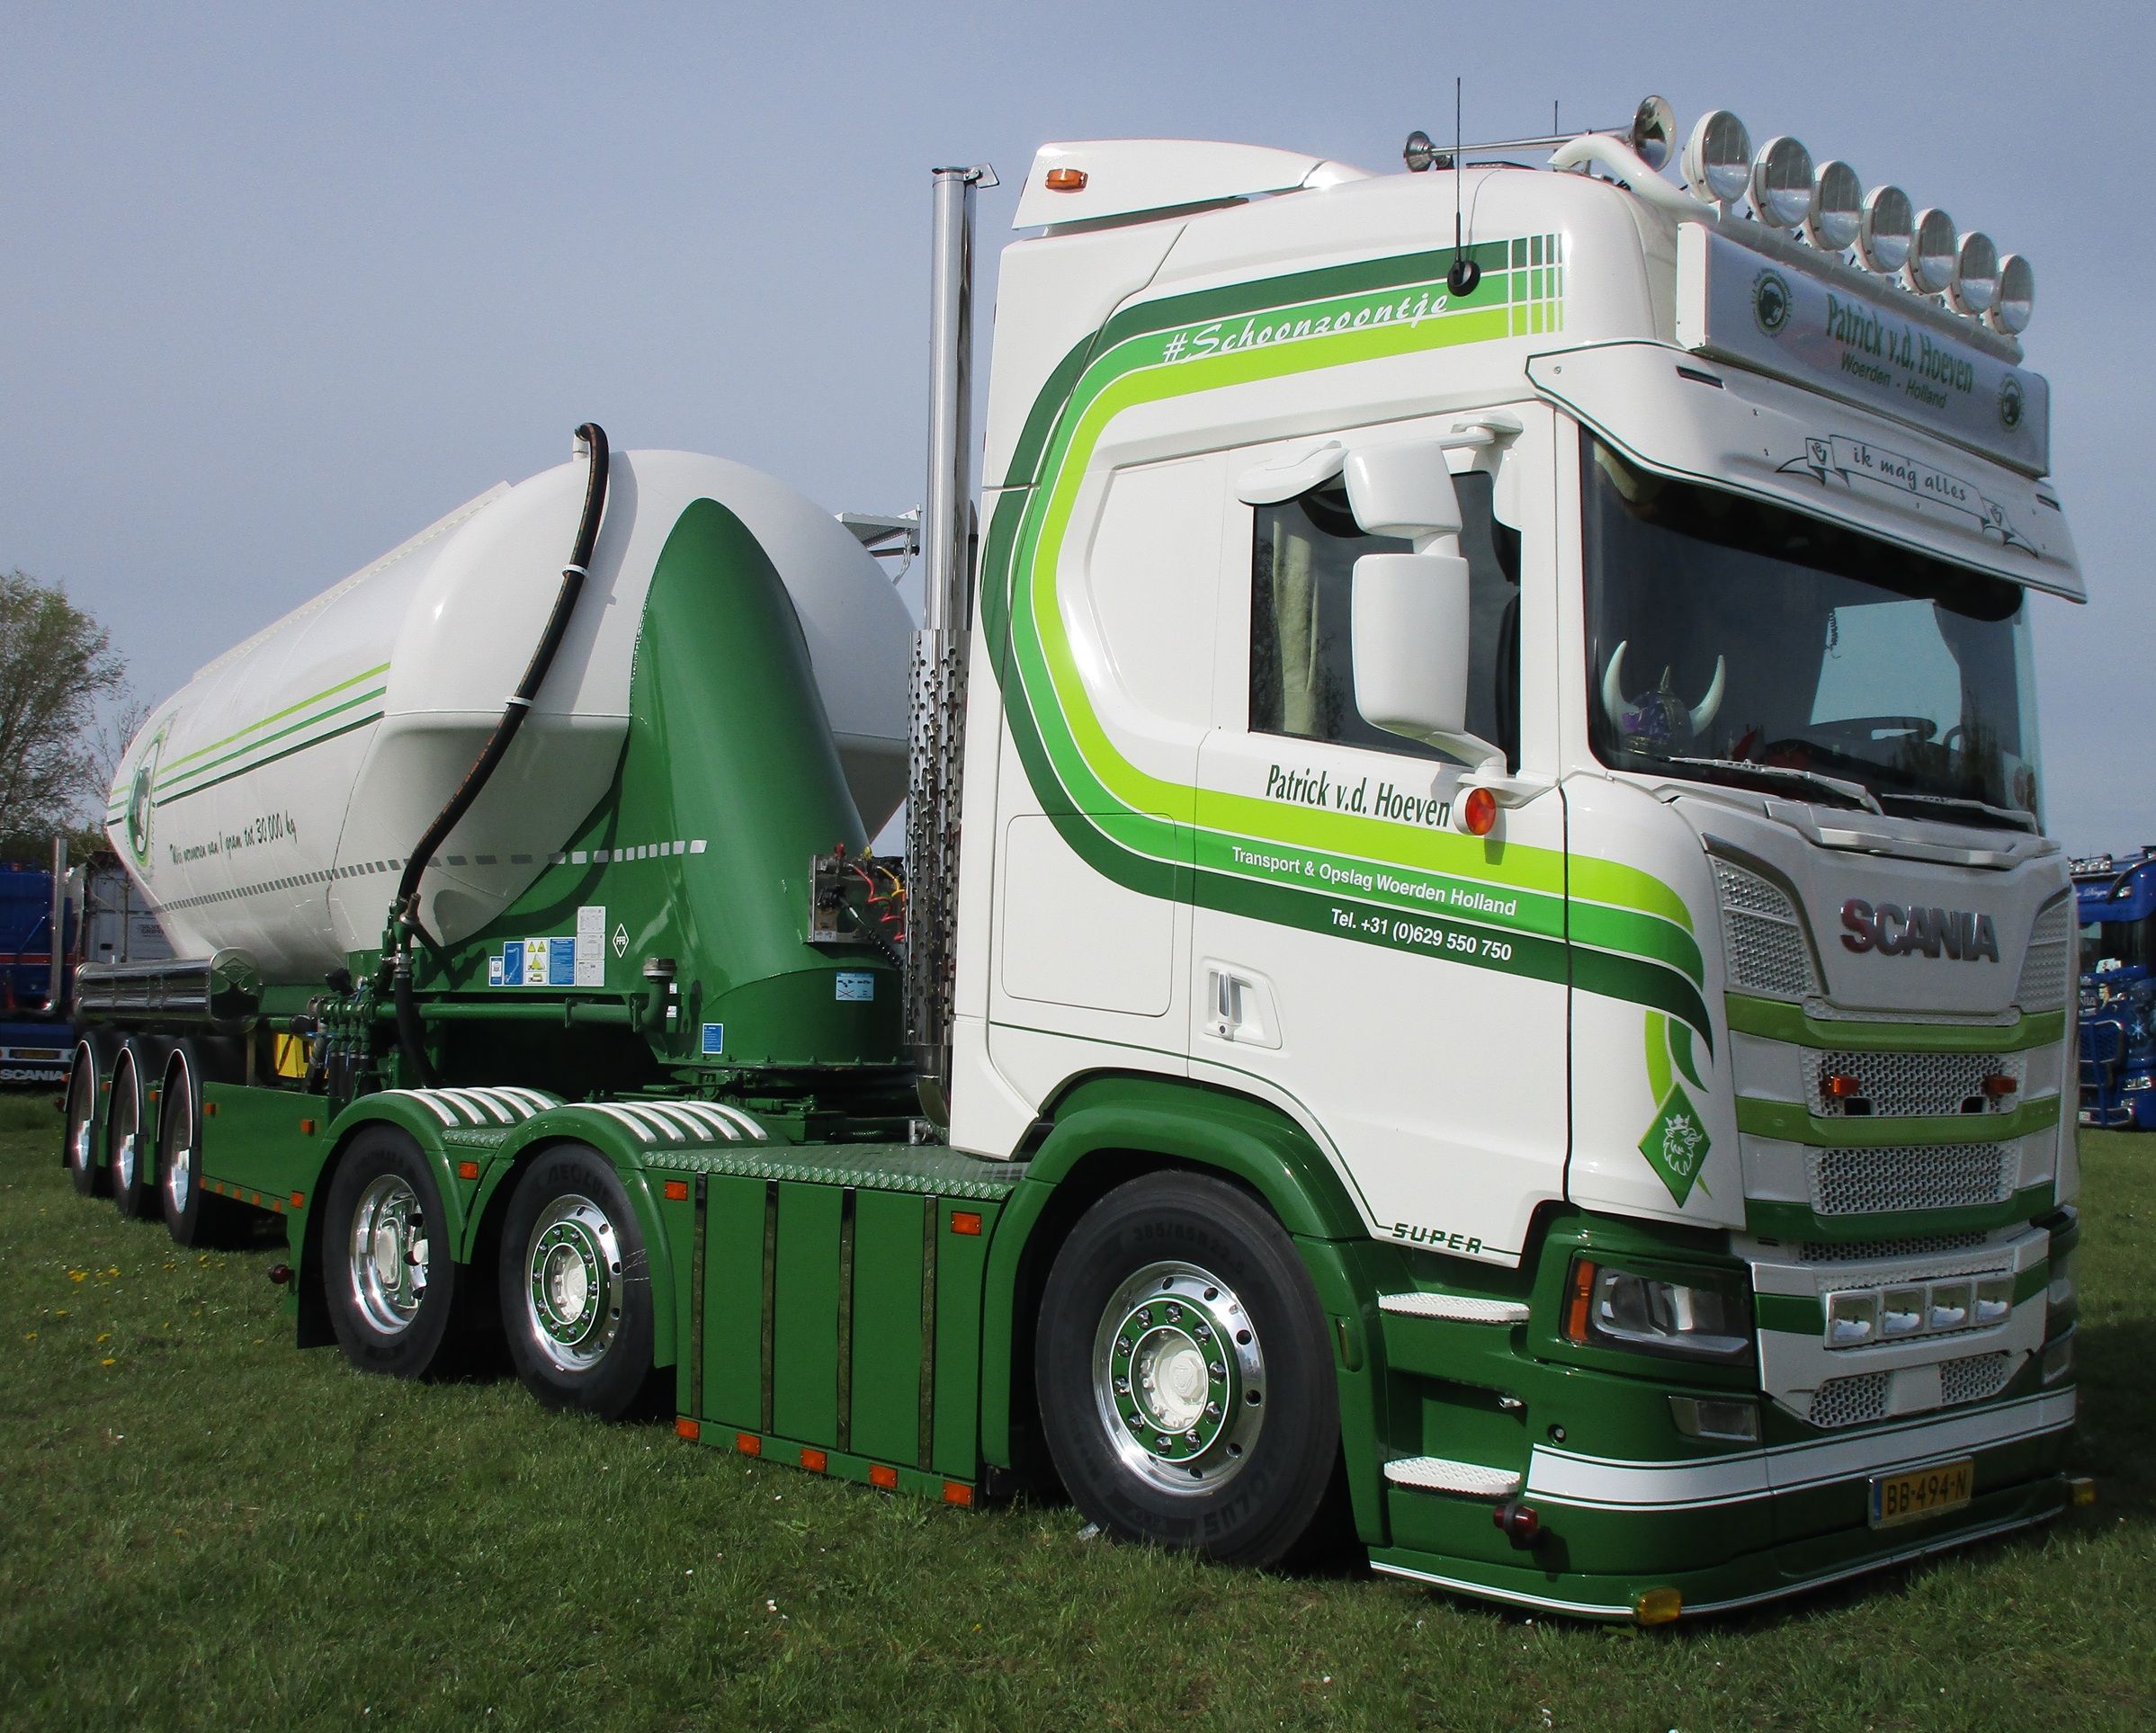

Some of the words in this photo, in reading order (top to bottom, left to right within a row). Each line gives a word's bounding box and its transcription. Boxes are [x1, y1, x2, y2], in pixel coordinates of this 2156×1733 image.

[1162, 293, 1448, 365] #Schoonzoontje
[1826, 293, 1883, 358] Patrick
[1888, 324, 1916, 370] v.d.
[1919, 332, 1973, 394] Hoeven
[1841, 351, 1892, 387] Woerden
[1906, 378, 1947, 408] Holland
[1853, 446, 1873, 468] ik
[1925, 477, 1966, 502] alles
[1266, 764, 1329, 807] Patrick
[1336, 777, 1368, 814] v.d.
[1374, 782, 1451, 828] Hoeven
[1231, 845, 1301, 875] Transport
[1304, 860, 1315, 877] &
[1319, 862, 1373, 892] Opslag
[1376, 873, 1446, 904] Woerden
[1451, 888, 1517, 917] Holland
[616, 936, 626, 945] FFB
[1330, 907, 1357, 930] Tel.
[1361, 916, 1389, 935] +31
[1392, 920, 1443, 947] (0)629
[1446, 933, 1477, 954] 550
[1481, 939, 1513, 961] 750
[1839, 898, 1999, 964] SCANIA
[0, 1068, 64, 1081] SCANIA
[1391, 1222, 1482, 1254] SUPER
[1887, 1469, 1967, 1515] BB-494-N
